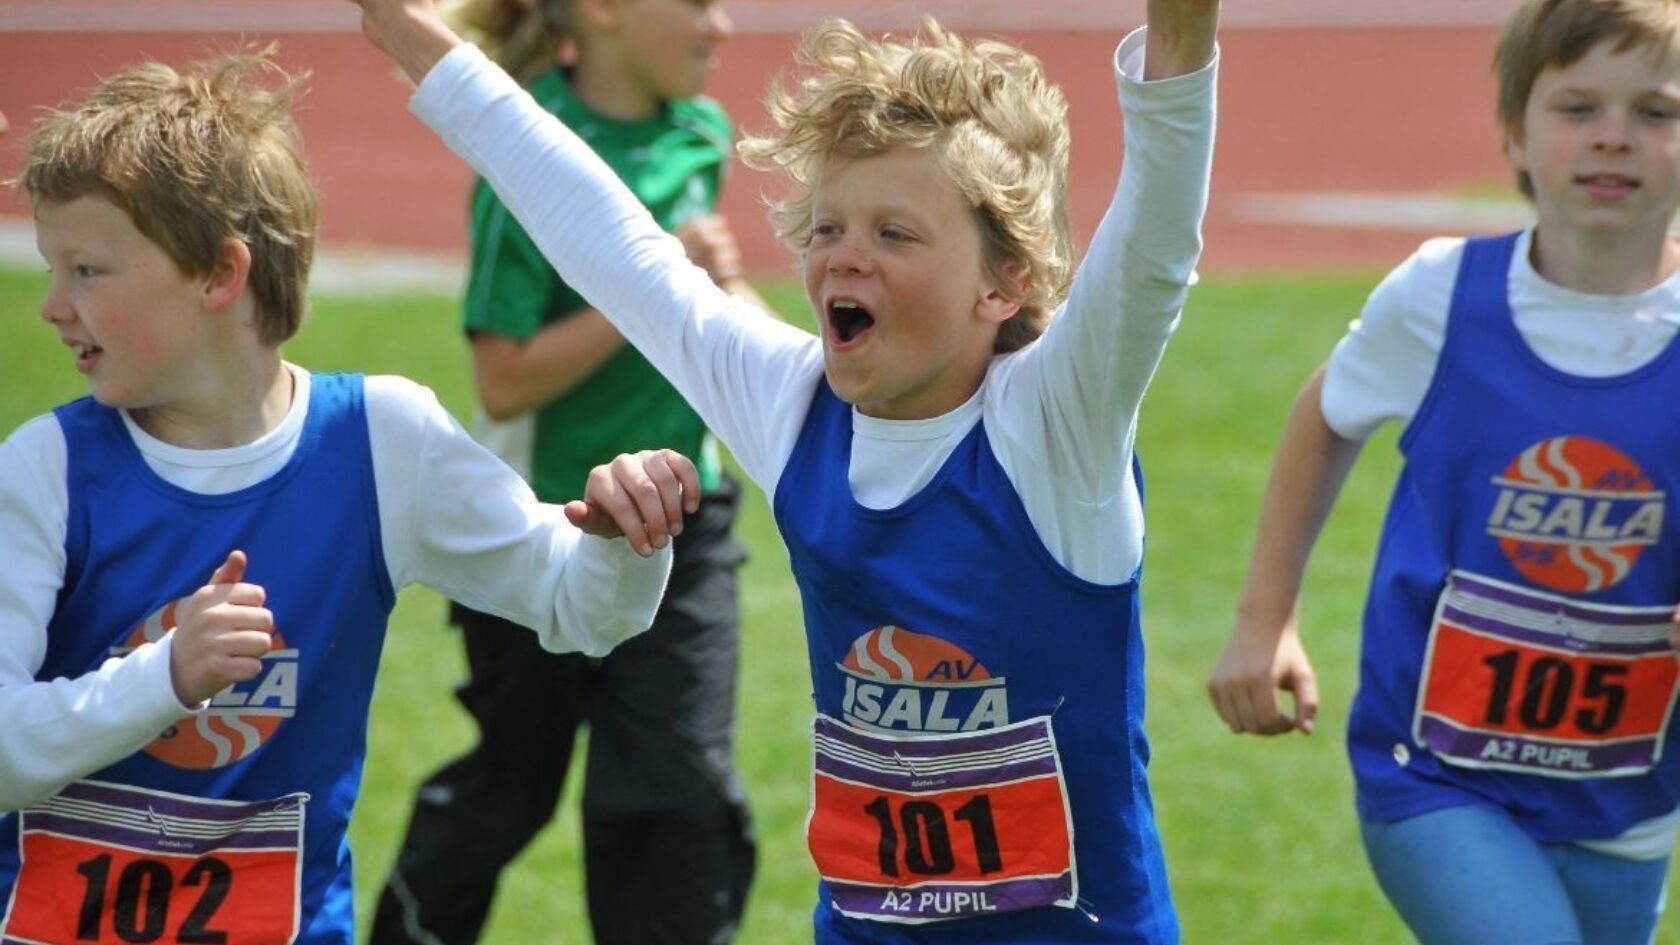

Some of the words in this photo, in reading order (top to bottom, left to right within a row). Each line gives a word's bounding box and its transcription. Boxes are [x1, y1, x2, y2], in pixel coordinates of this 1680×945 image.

[1490, 490, 1666, 539] ISALA
[926, 660, 979, 681] AV
[1483, 650, 1630, 735] 105
[842, 676, 1009, 732] ISALA
[1480, 739, 1516, 761] A2
[1520, 744, 1595, 769] PUPIL
[864, 795, 1003, 878] 101
[76, 853, 233, 944] 102
[880, 890, 912, 912] A2
[918, 891, 997, 914] PUPIL
